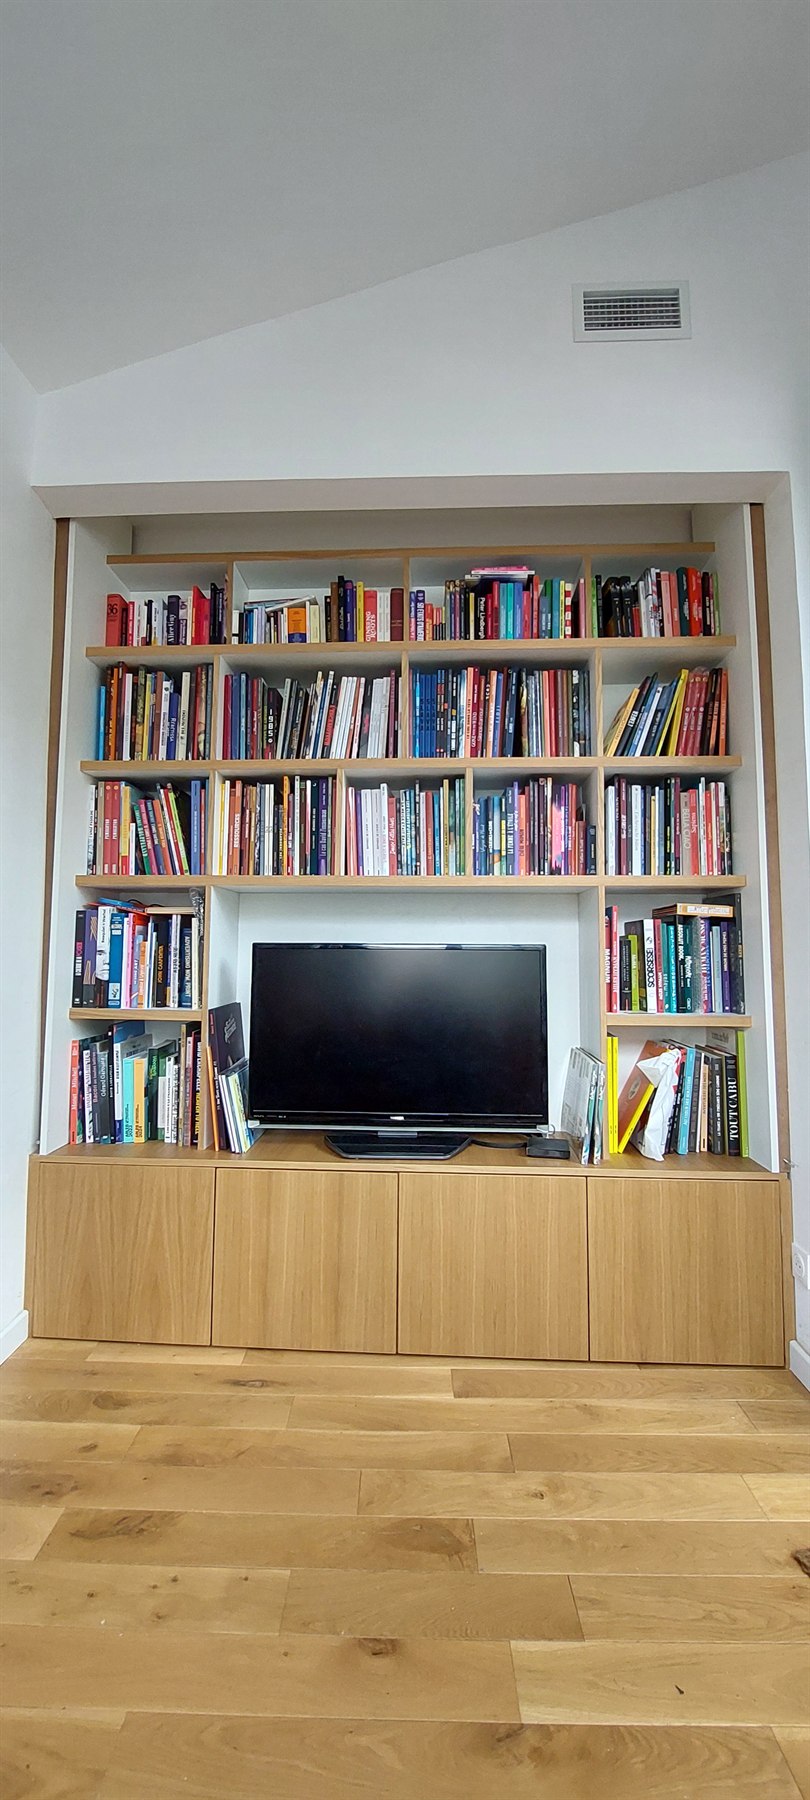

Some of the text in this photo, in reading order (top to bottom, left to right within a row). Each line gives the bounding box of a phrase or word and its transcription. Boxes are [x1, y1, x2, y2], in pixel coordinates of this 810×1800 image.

[627, 710, 638, 728] L'ENFER
[646, 948, 655, 988] SCORSESE
[728, 1077, 738, 1140] TOUT CABU
